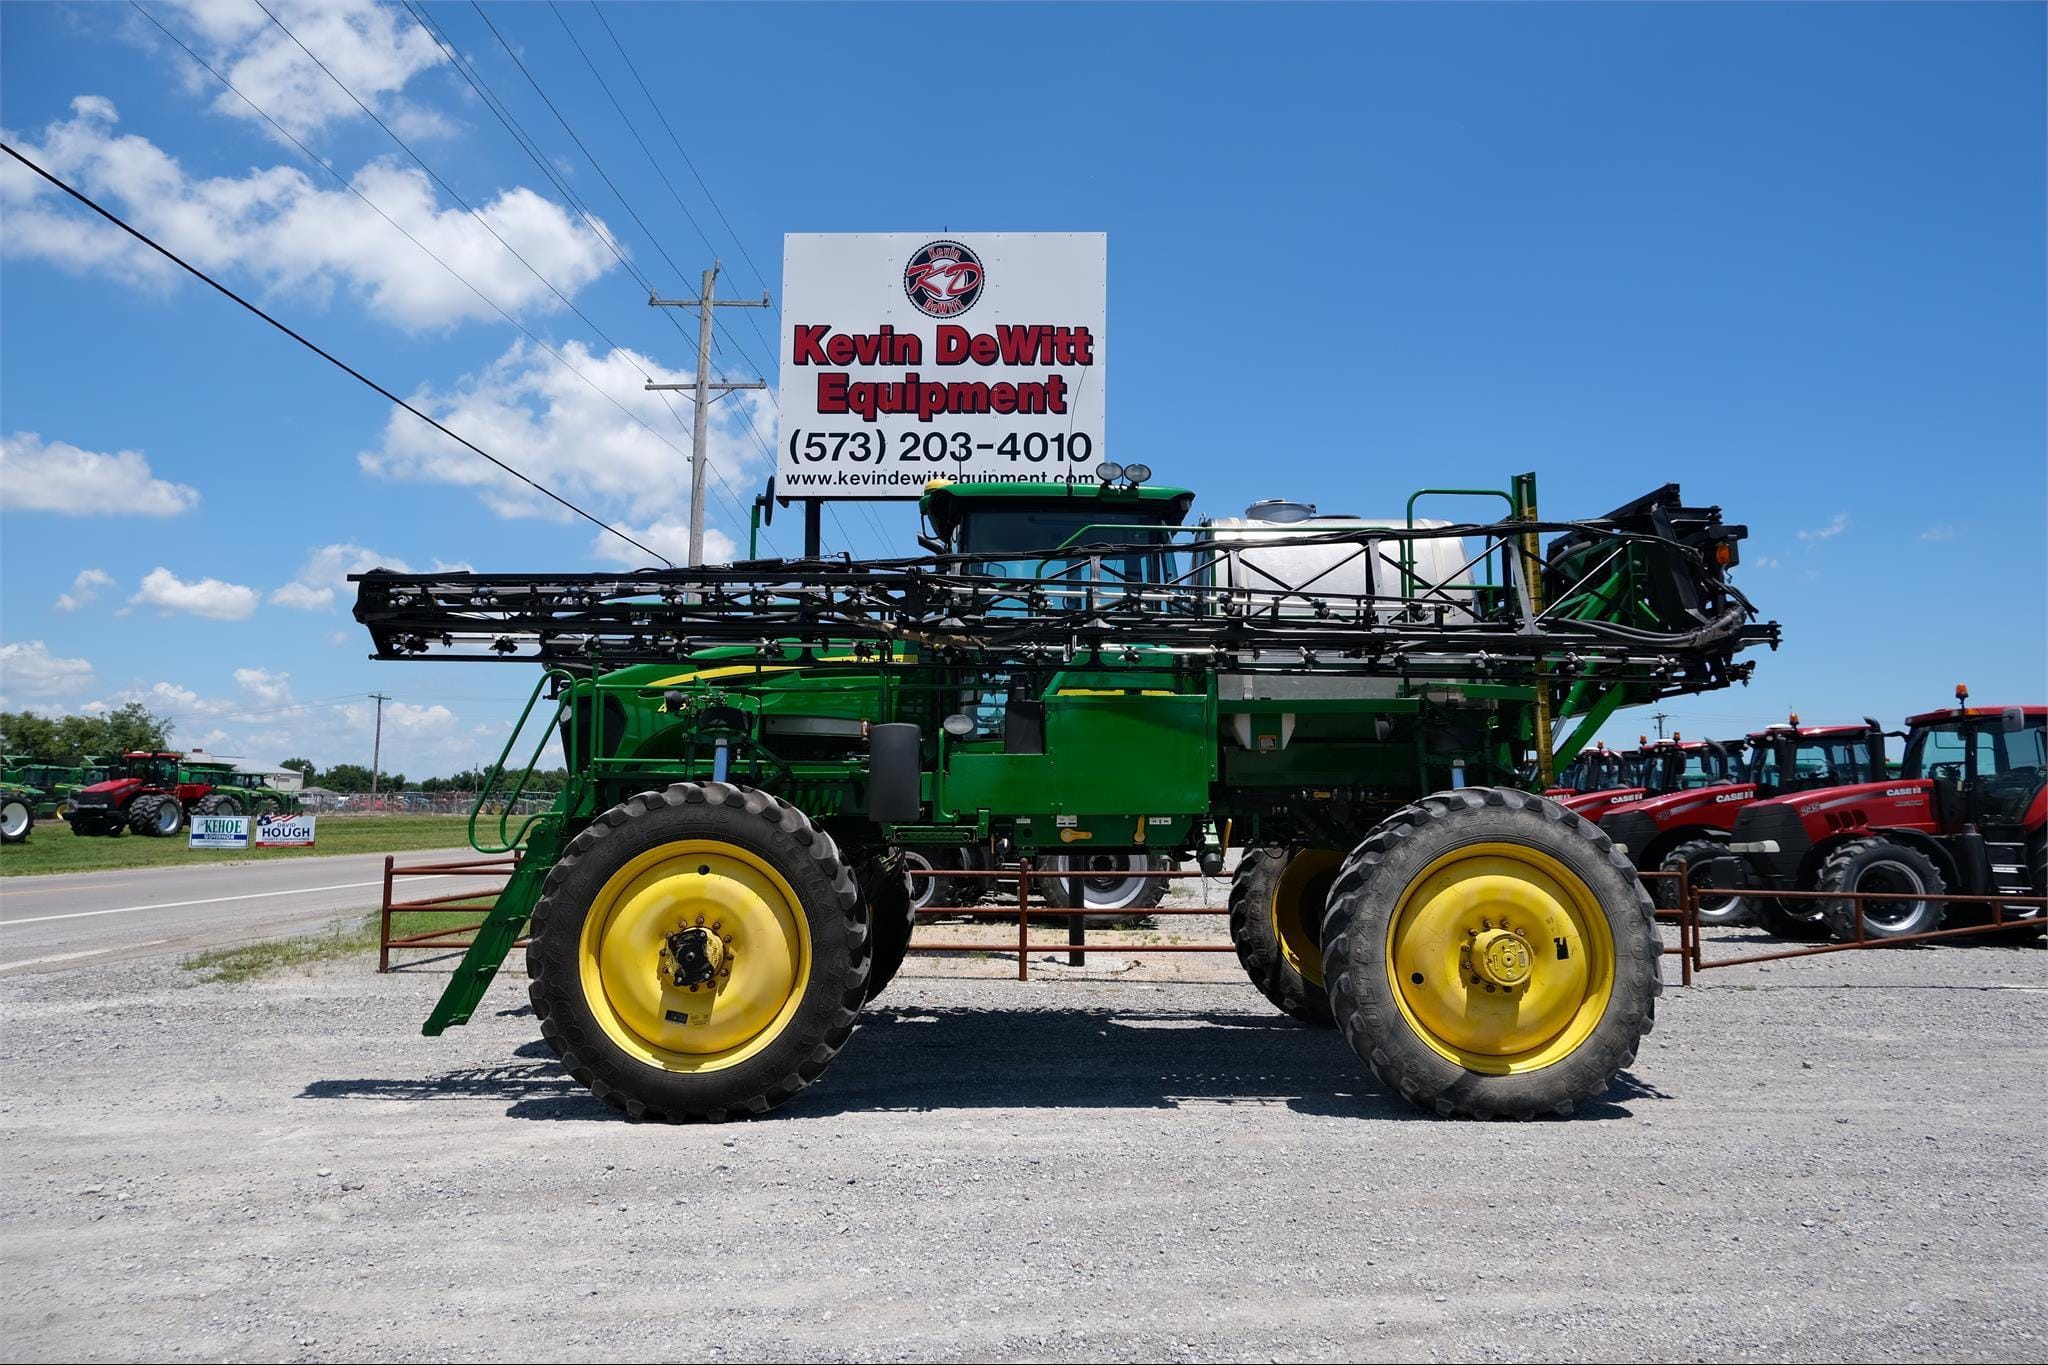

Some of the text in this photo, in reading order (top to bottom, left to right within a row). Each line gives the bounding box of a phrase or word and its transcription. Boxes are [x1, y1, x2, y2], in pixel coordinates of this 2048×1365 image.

[928, 246, 961, 260] Kevin
[906, 262, 983, 297] KD
[793, 324, 1094, 366] Kevin DeWitt
[817, 372, 1068, 423] Equipment
[790, 428, 1092, 465] (573) 203-4010
[786, 470, 1094, 485] www.kevindewittequipmentcom
[1716, 791, 1744, 803] CASE
[1886, 787, 1912, 797] CASE
[1611, 795, 1634, 804] CASE
[205, 819, 242, 833] KEHOE
[262, 828, 310, 838] HOUGH
